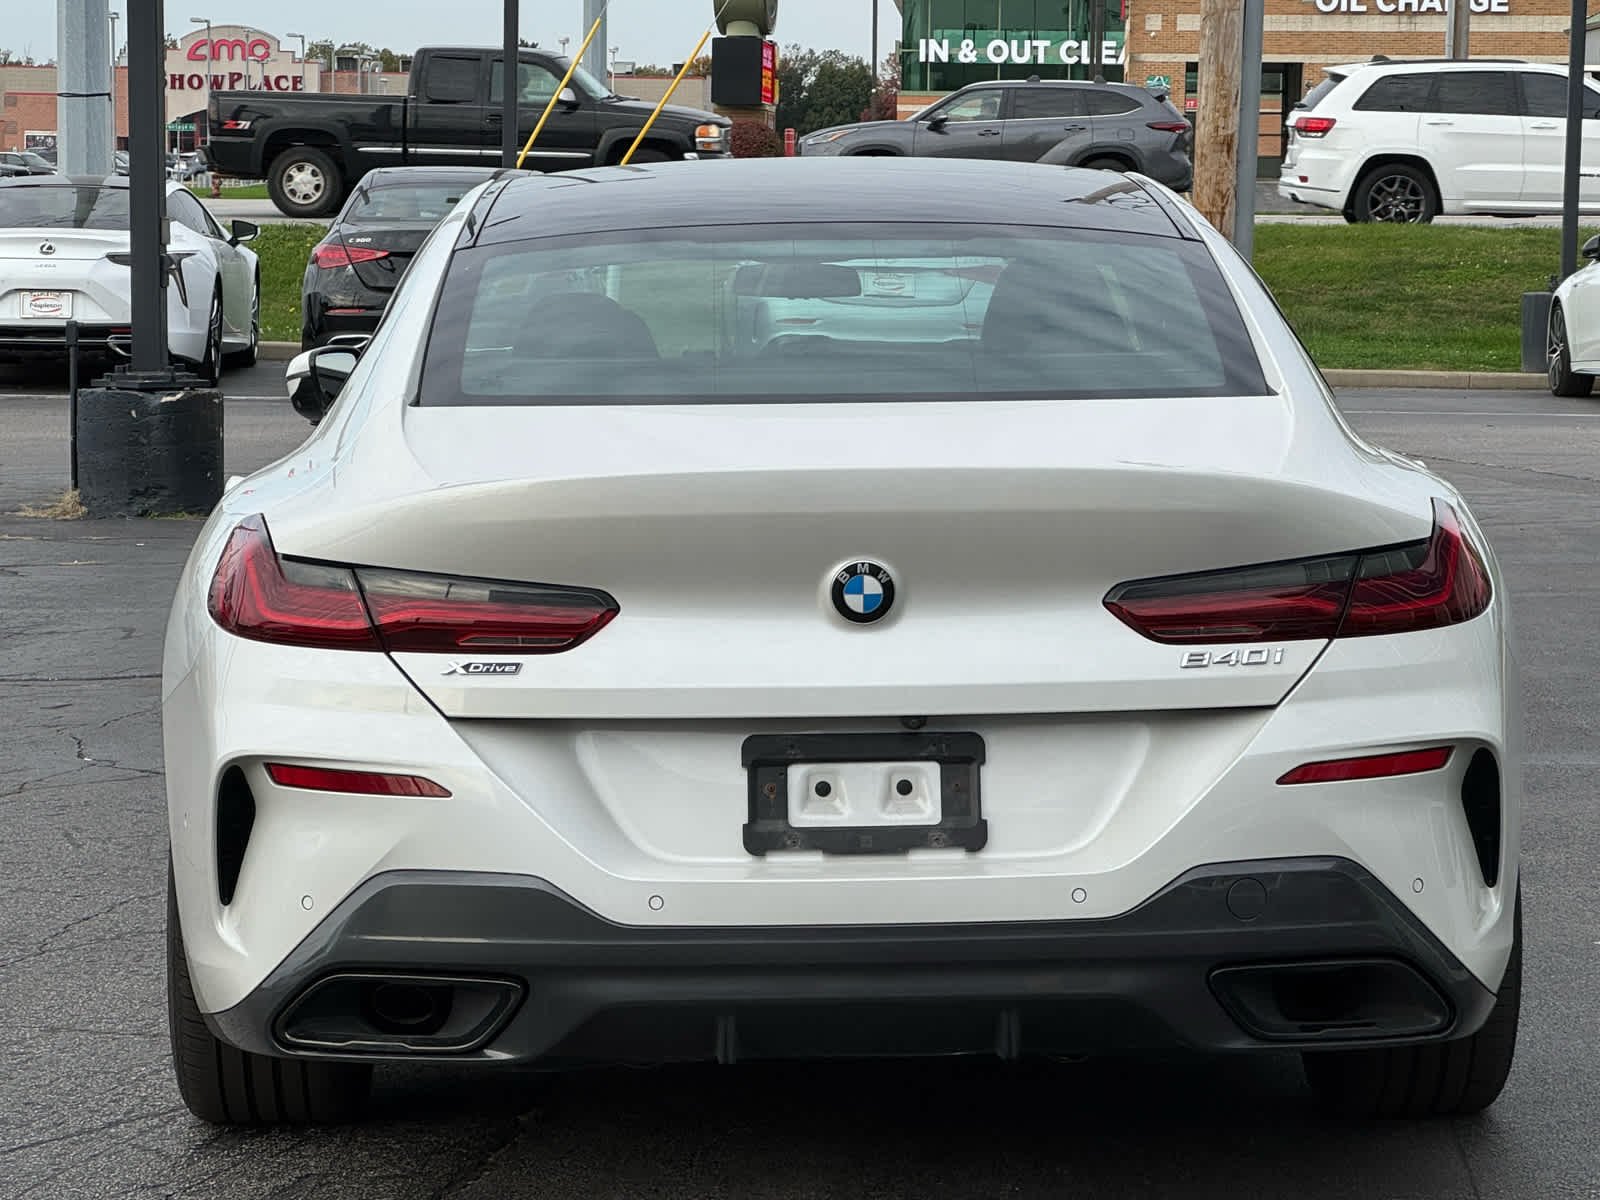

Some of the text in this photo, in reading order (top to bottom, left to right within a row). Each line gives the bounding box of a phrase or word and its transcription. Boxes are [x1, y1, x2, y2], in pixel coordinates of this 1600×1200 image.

[1315, 0, 1509, 13] OIL CHAGE
[919, 38, 949, 63] IN
[958, 39, 977, 63] &
[986, 39, 1051, 64] OUT
[166, 72, 304, 91] HOWPLACE
[837, 563, 891, 585] BMW
[1180, 647, 1284, 668] 840i
